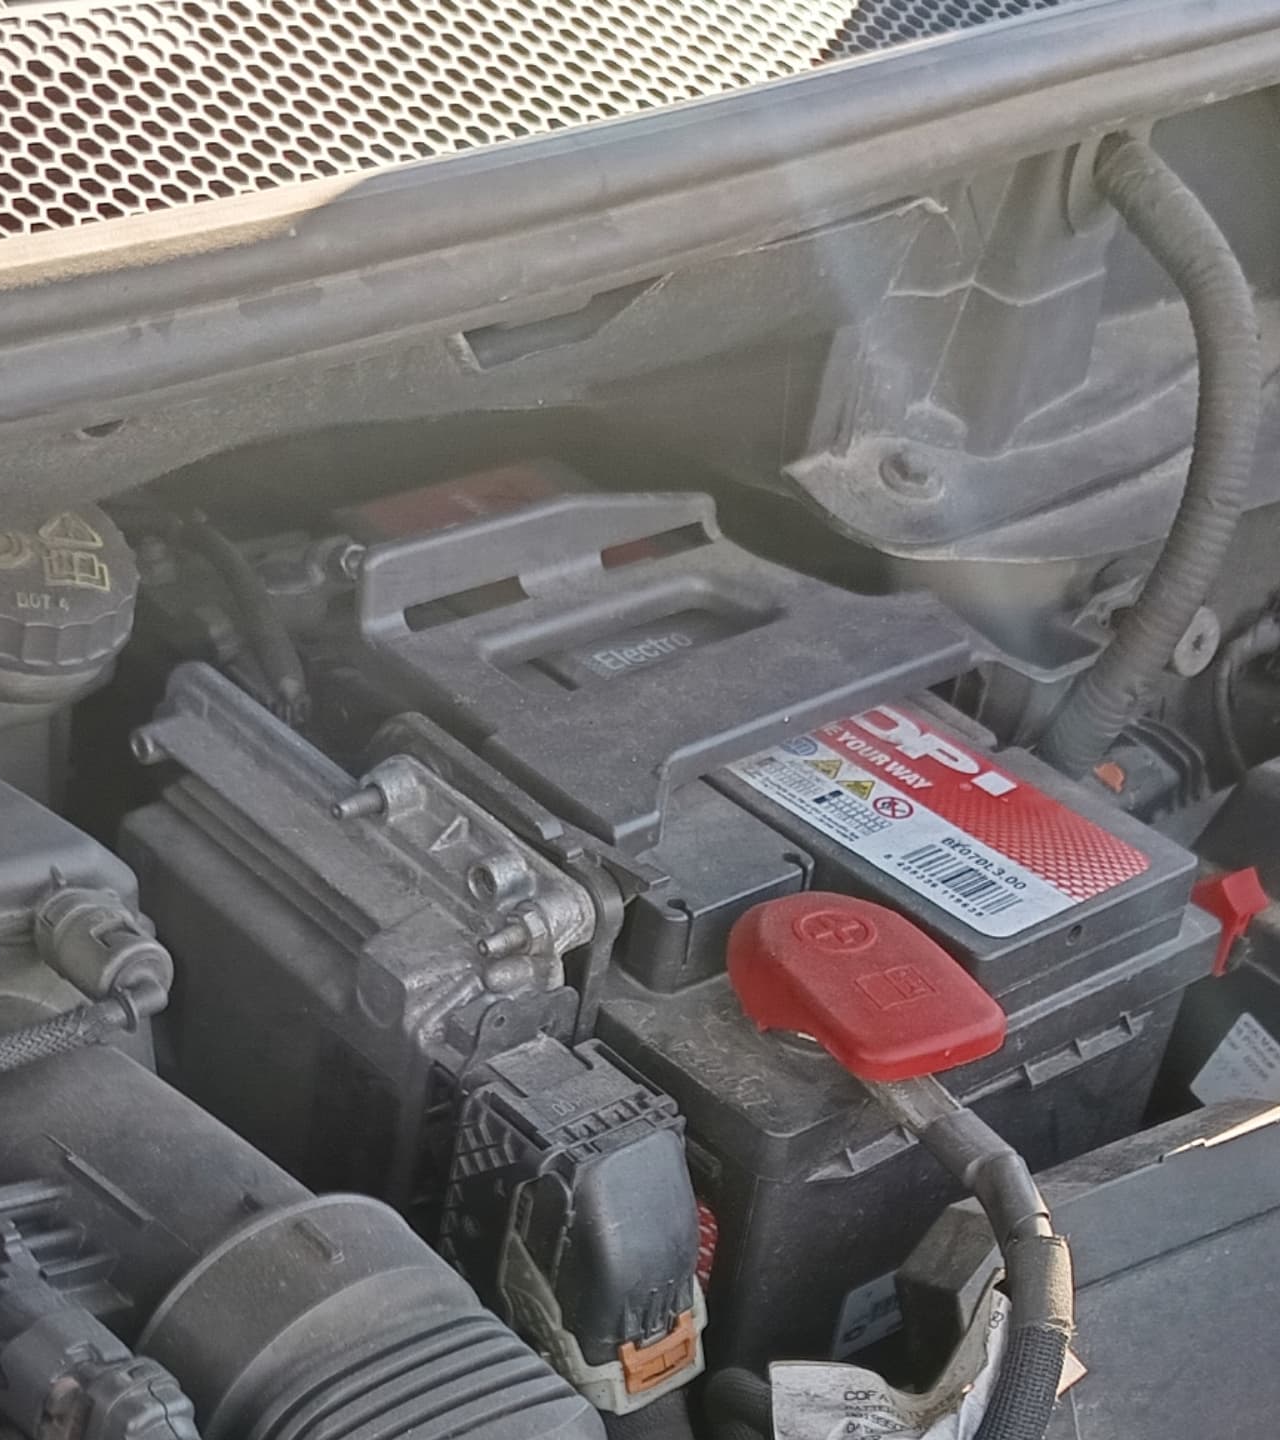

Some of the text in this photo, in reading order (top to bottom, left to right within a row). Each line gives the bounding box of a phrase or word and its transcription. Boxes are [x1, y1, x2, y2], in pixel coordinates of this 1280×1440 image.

[593, 632, 693, 671] Electro
[836, 731, 891, 766] YOUR
[885, 758, 934, 790] WAY
